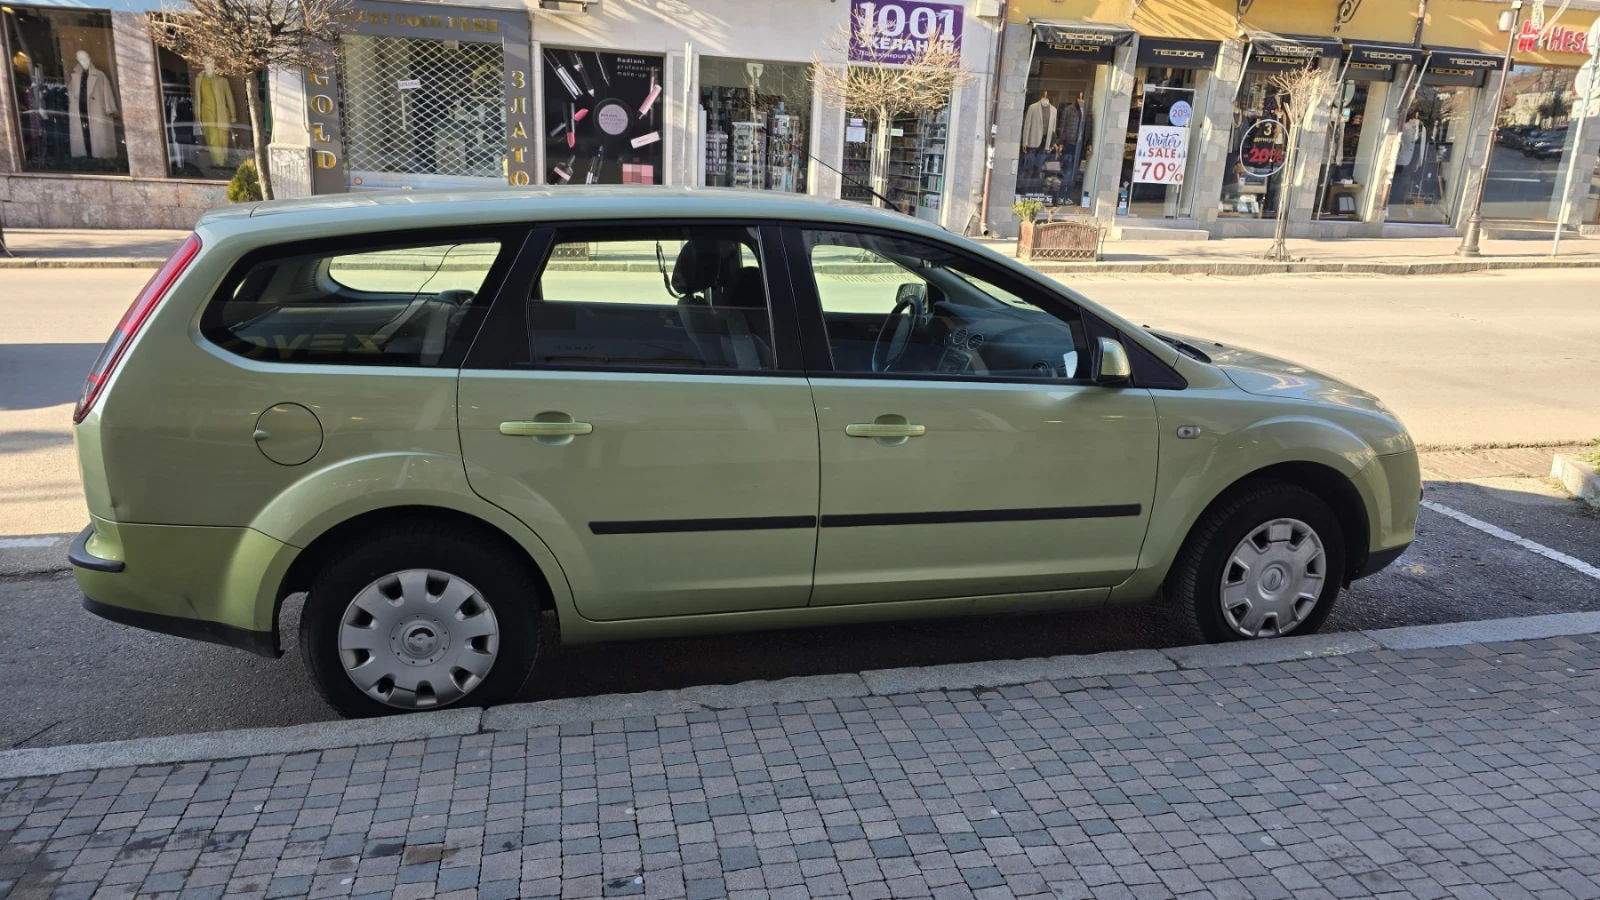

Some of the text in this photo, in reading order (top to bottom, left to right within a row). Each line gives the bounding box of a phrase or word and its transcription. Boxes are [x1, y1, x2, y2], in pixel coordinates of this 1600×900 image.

[394, 14, 442, 28] GOLD
[859, 2, 955, 41] 1001
[1057, 32, 1114, 42] TEODOR
[1047, 43, 1100, 52] TEODOR
[1153, 48, 1205, 58] TEODOR
[1362, 51, 1413, 61] TEODOR
[1256, 55, 1305, 64] TEODOR
[1449, 57, 1498, 67] TEODOR
[1344, 61, 1391, 71] TEODOR
[1430, 67, 1475, 76] TEODOR
[510, 70, 530, 186] ЗЛАТО
[1263, 122, 1273, 136] 3
[1146, 132, 1182, 149] Winter
[1148, 148, 1177, 158] SALE
[1243, 147, 1283, 163] -20%
